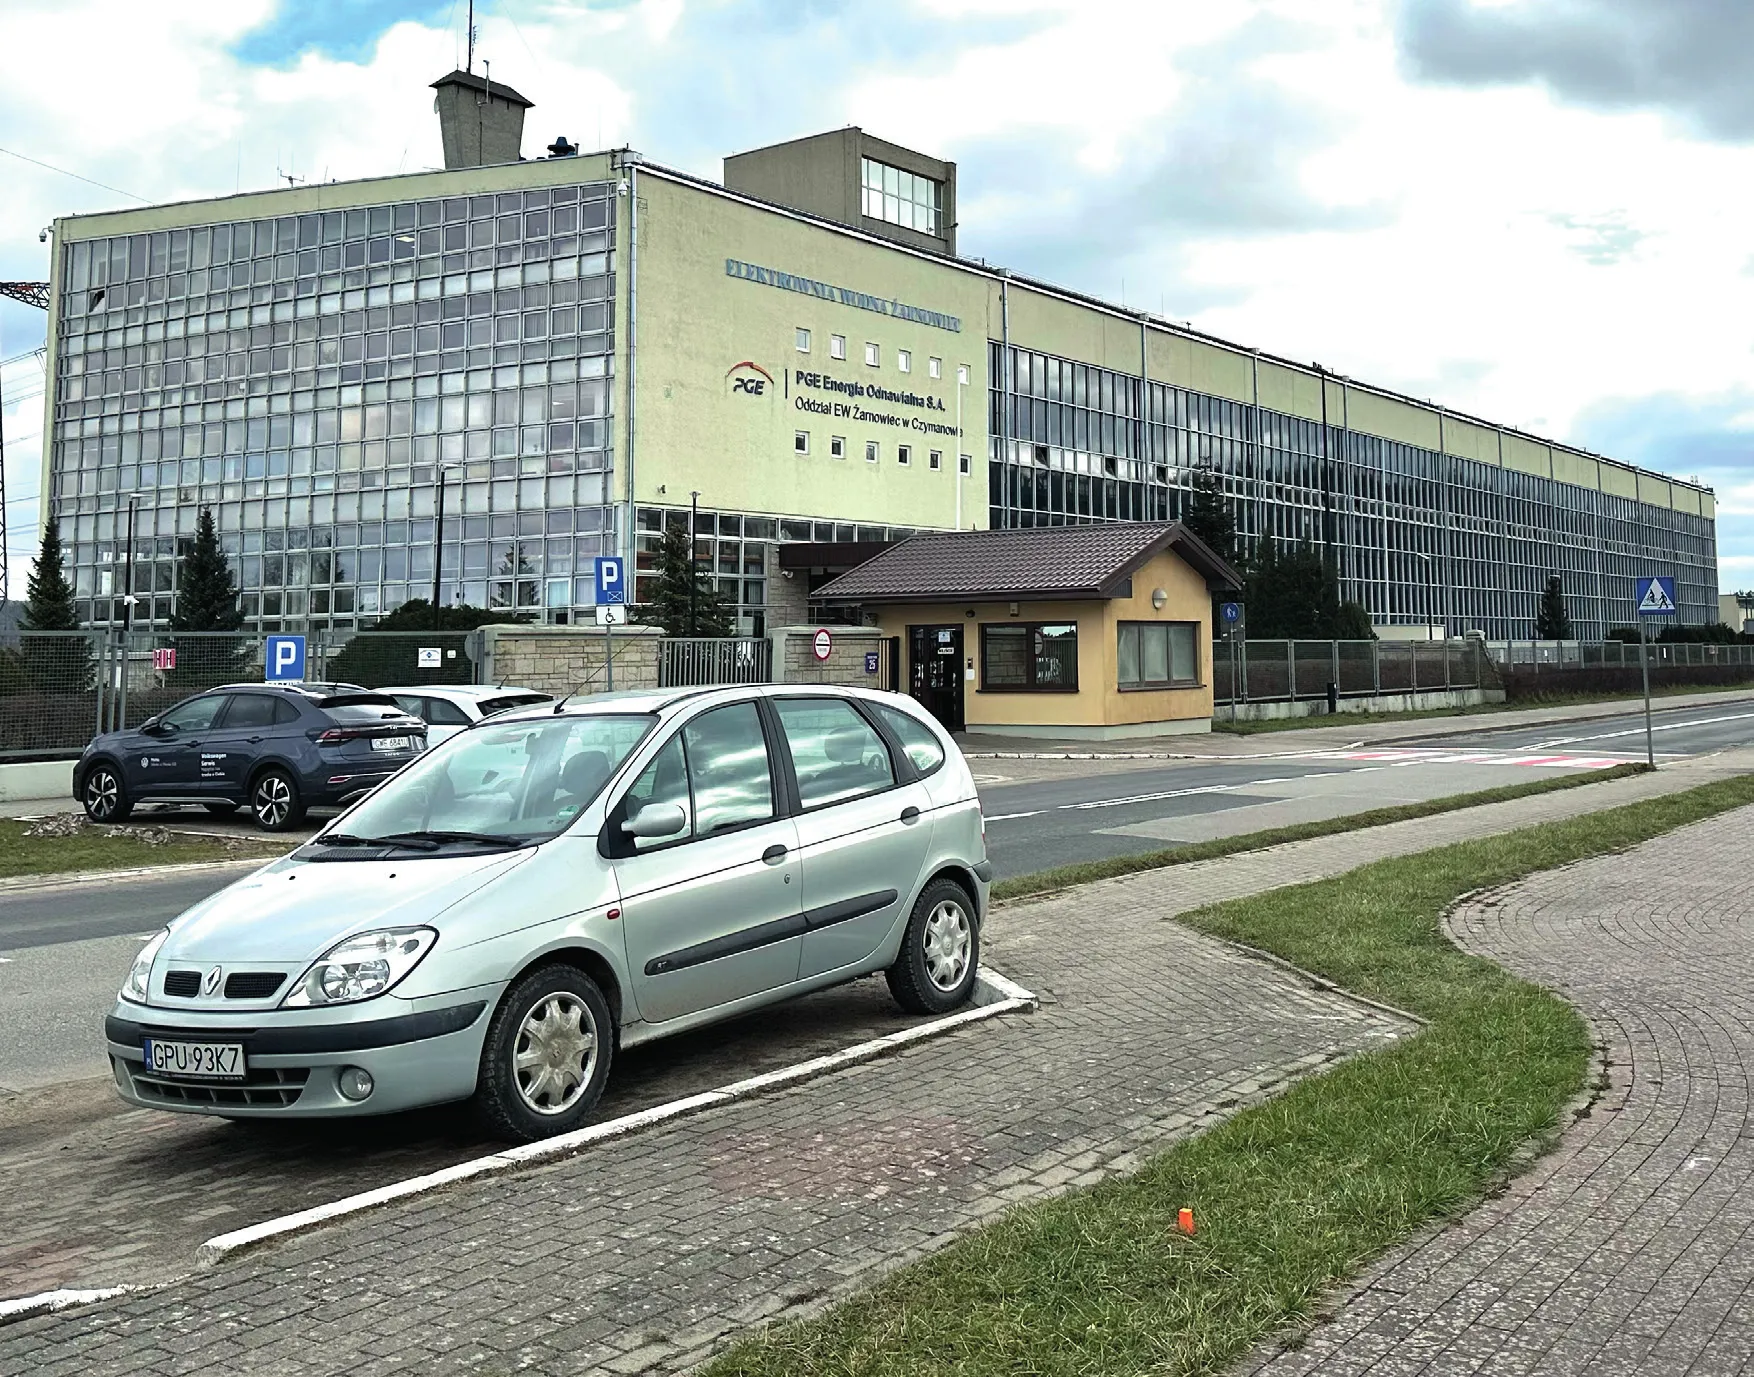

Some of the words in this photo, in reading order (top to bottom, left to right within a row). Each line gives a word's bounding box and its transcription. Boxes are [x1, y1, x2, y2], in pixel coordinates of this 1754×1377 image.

[733, 377, 765, 395] PGE
[796, 370, 821, 388] PGE
[823, 375, 864, 397] Energia
[866, 384, 925, 408] Odnawialna
[926, 395, 946, 412] S.A.
[795, 396, 832, 415] Oddział
[834, 403, 851, 418] EW
[852, 404, 900, 426] Żarnowiec
[902, 418, 910, 428] w
[601, 561, 618, 591] P
[275, 641, 296, 675] P
[153, 1043, 187, 1070] GPU
[193, 1047, 239, 1072] 93K7
